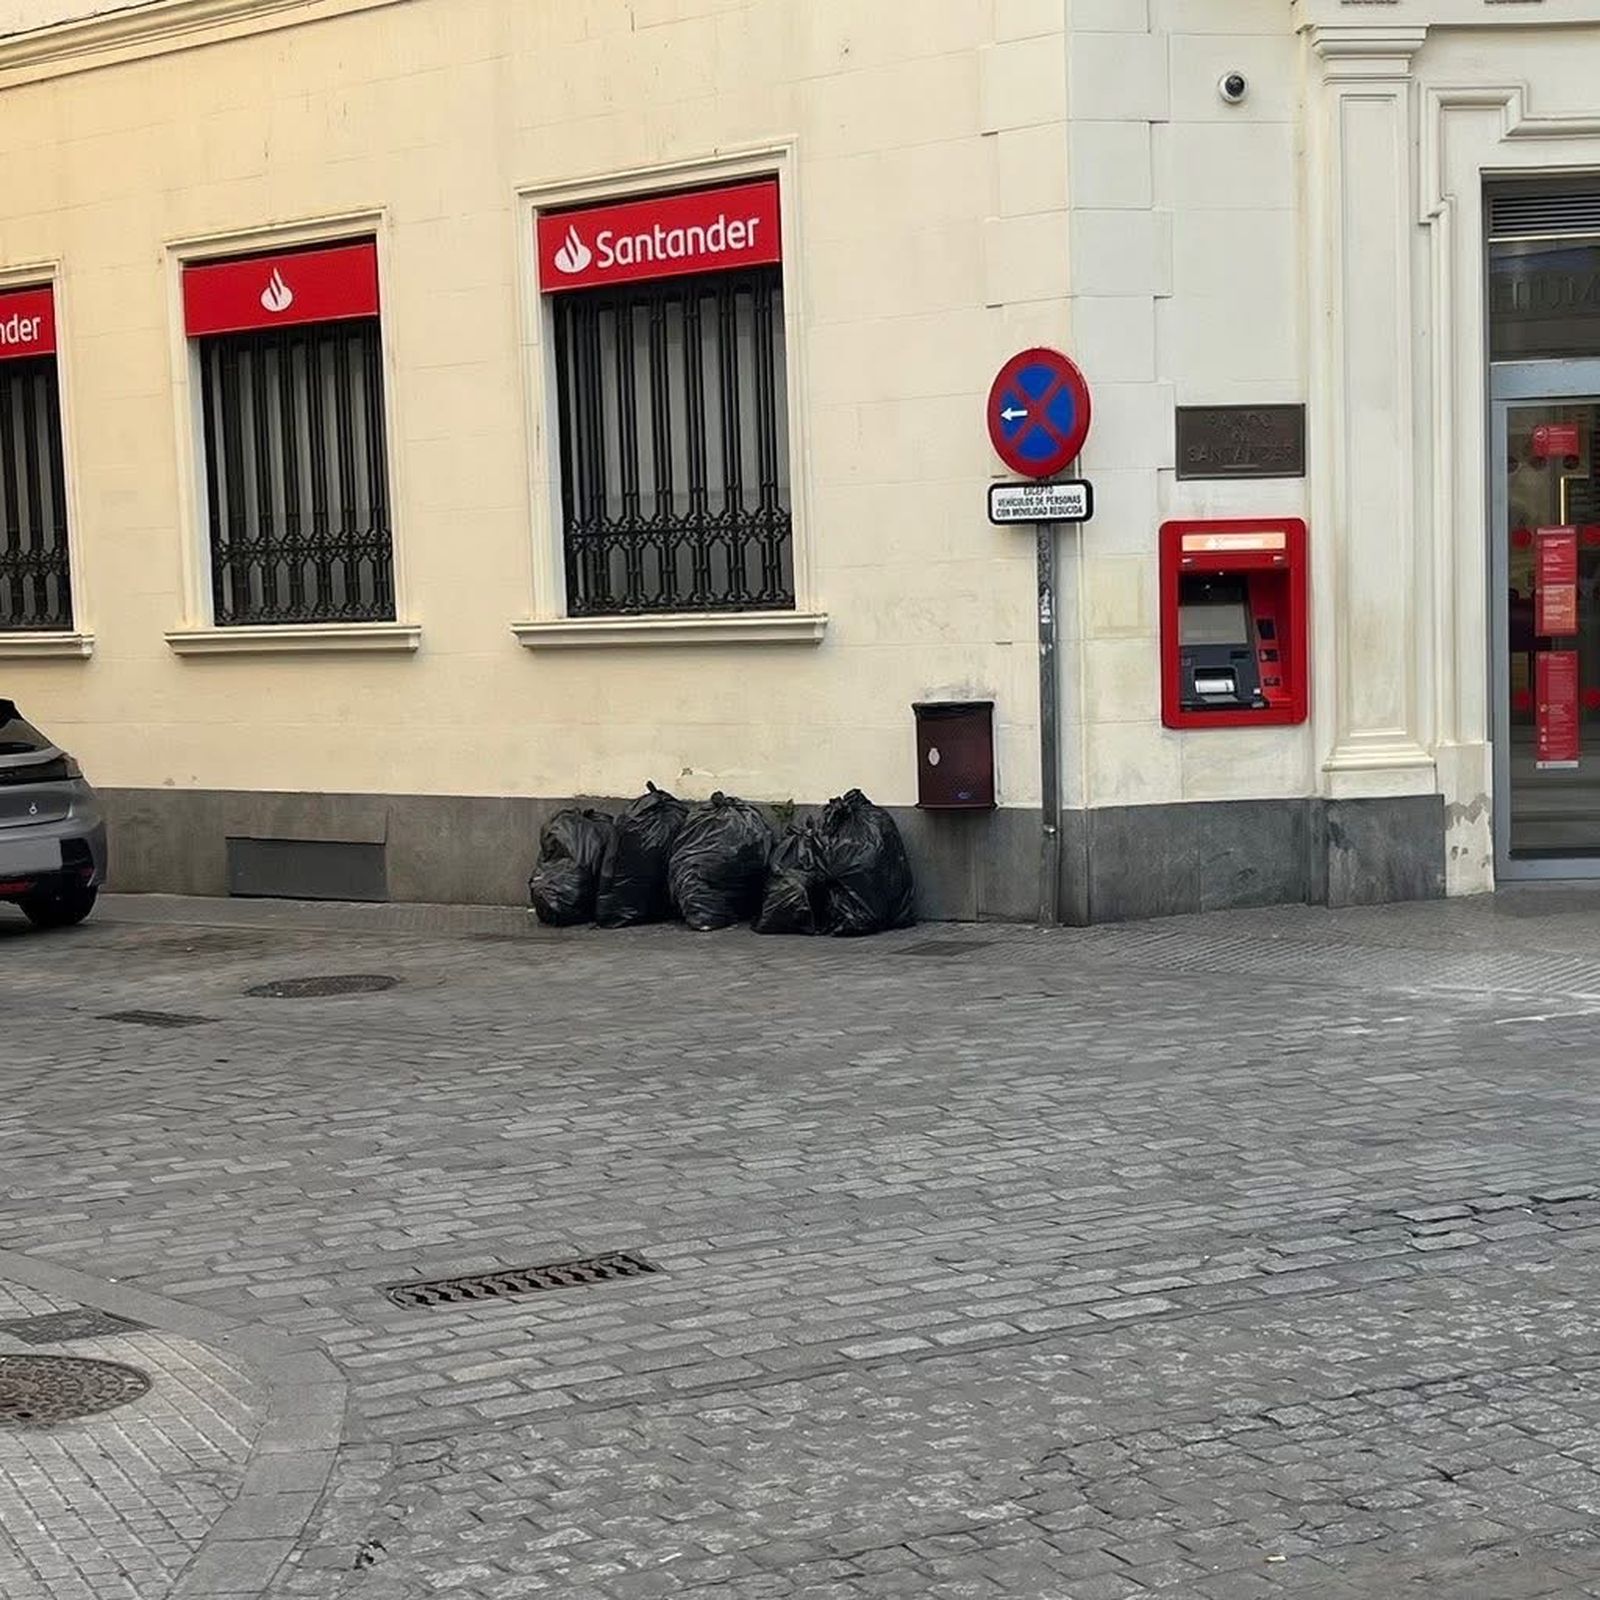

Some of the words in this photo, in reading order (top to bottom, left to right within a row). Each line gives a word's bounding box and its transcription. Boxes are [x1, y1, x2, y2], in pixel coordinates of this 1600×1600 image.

[596, 214, 760, 268] Santander
[1046, 494, 1081, 506] PERSONAS
[996, 508, 1010, 518] CON
[1012, 506, 1048, 517] MOVILIDAD
[1049, 504, 1083, 516] REDUCIDA
